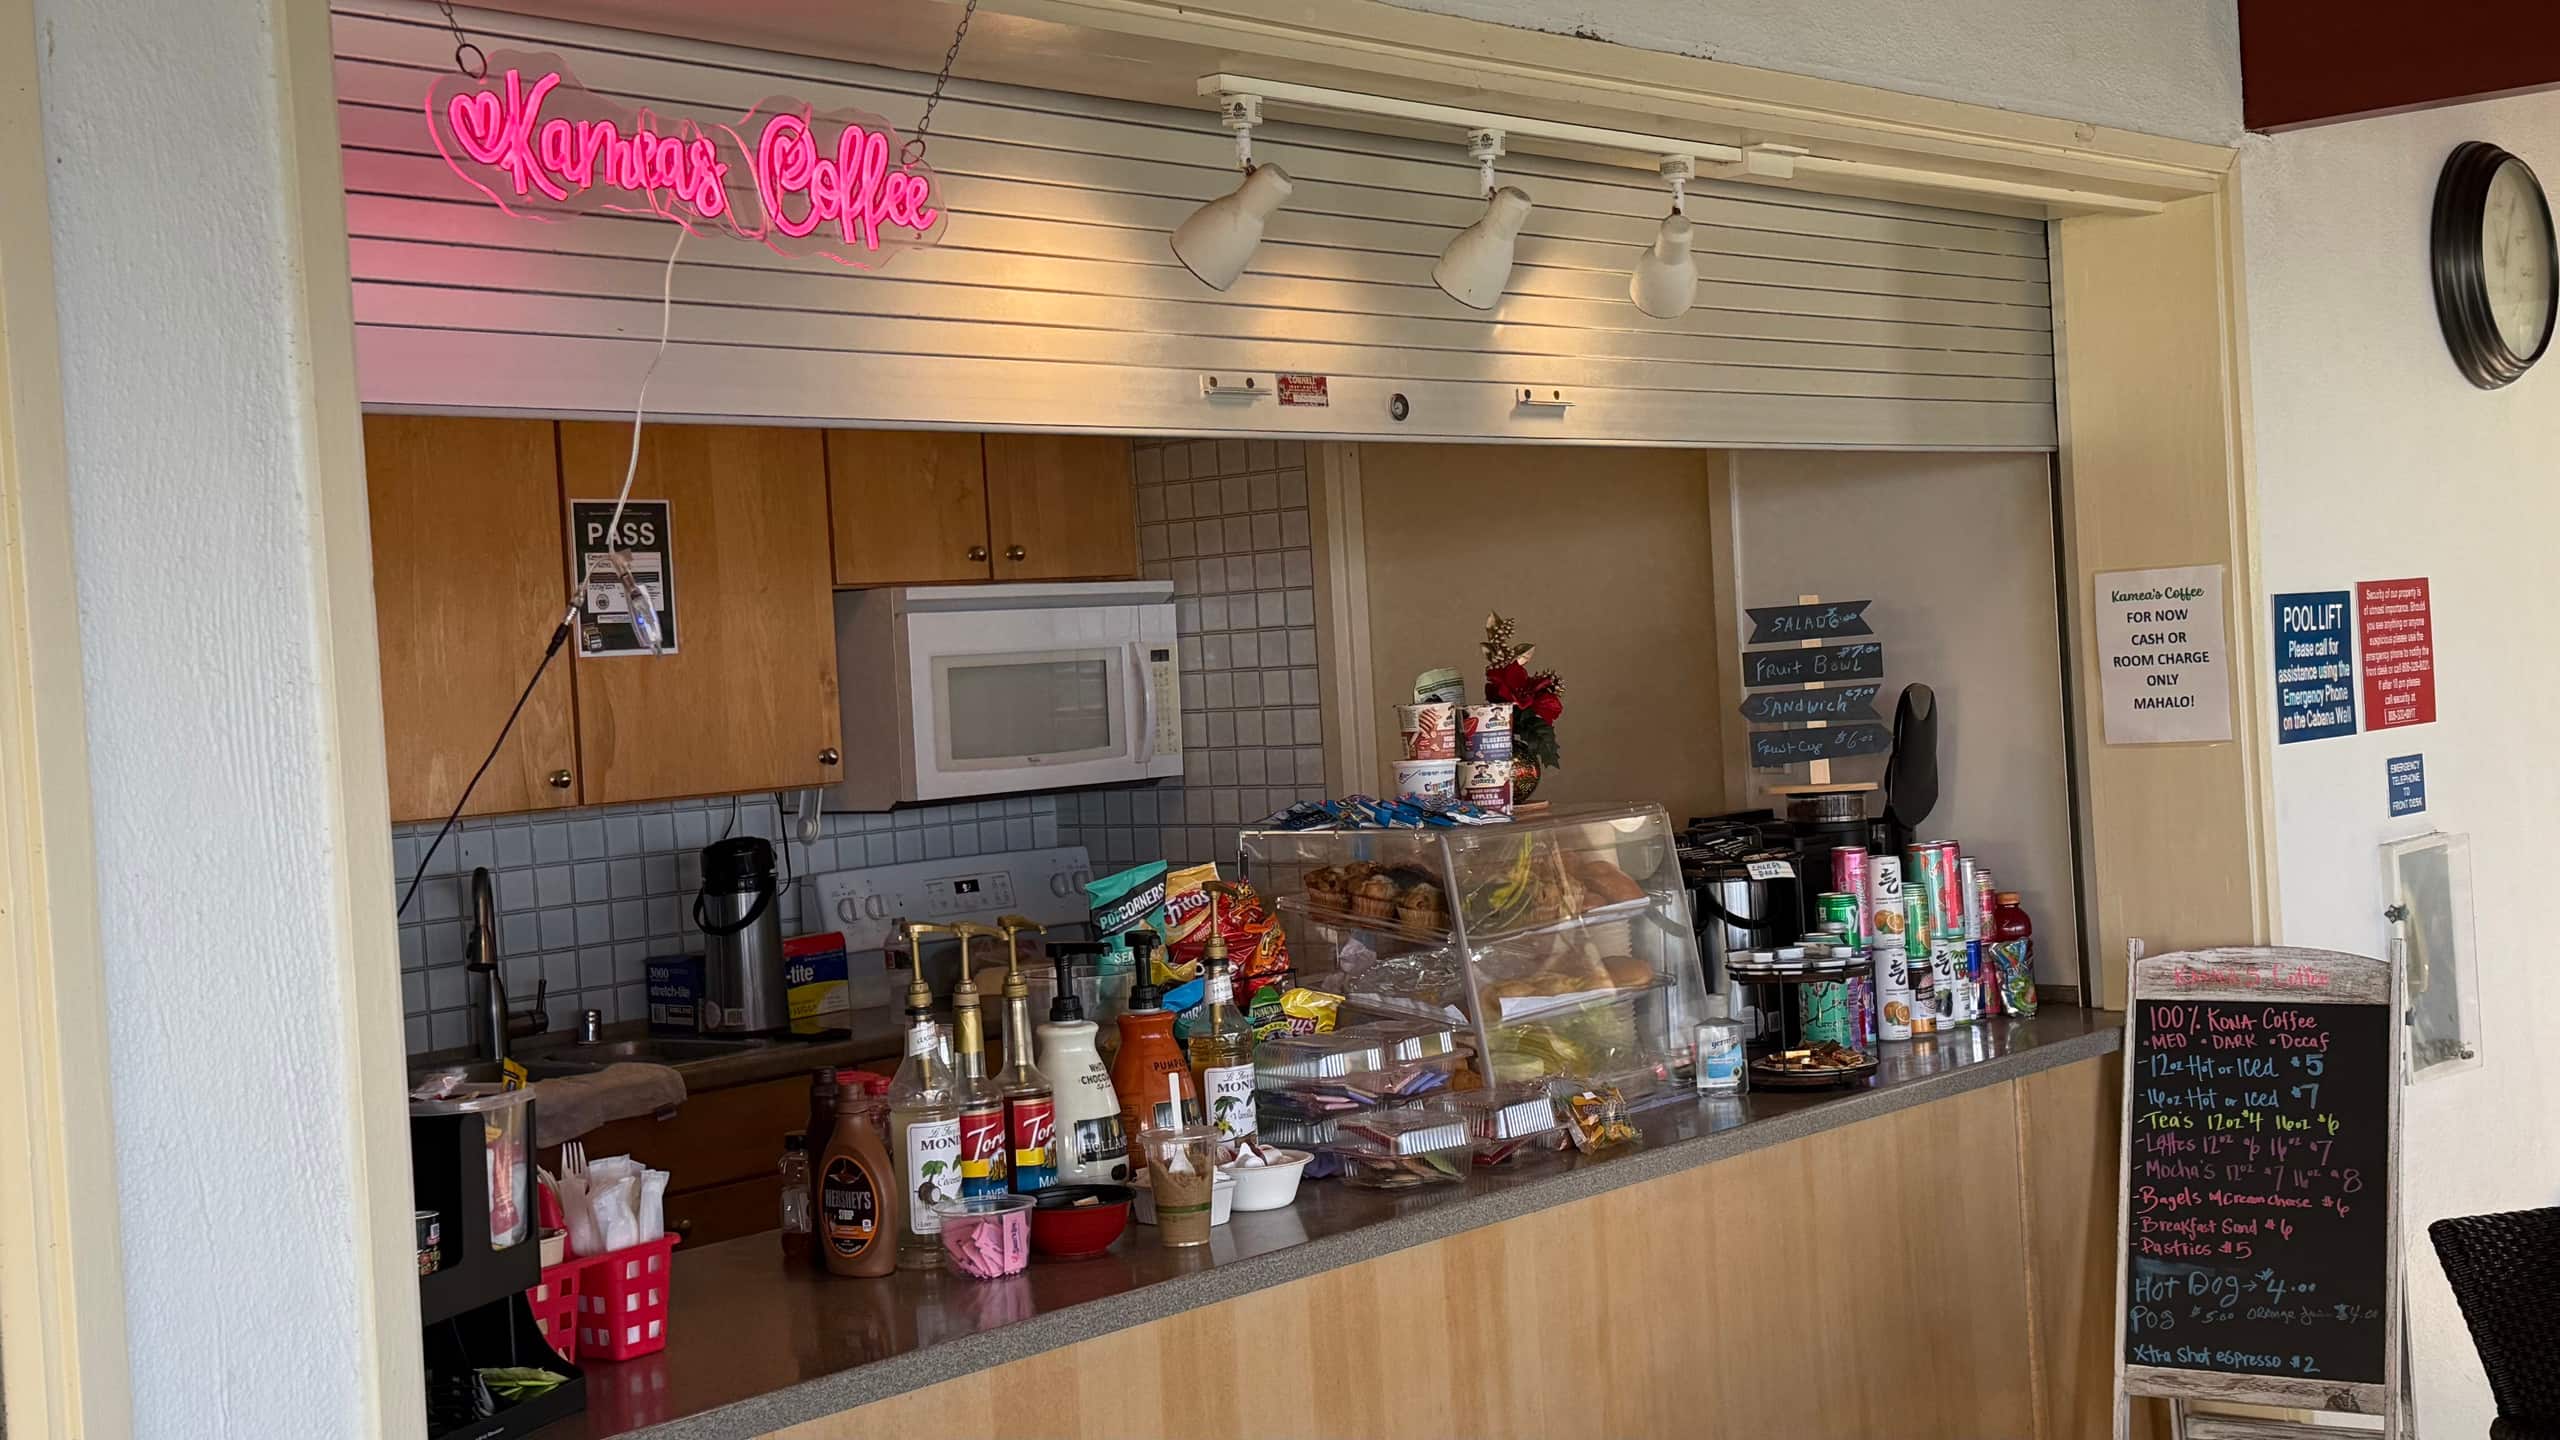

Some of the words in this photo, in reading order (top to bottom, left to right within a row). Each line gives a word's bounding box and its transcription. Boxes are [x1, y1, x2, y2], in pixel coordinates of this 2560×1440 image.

[758, 113, 938, 250] Coffee
[587, 522, 656, 546] PASS
[2111, 588, 2162, 603] Kamea's
[2164, 587, 2204, 601] Coffee
[1771, 615, 1826, 633] SALAD
[2127, 611, 2152, 623] FOR
[2155, 608, 2188, 622] NOW
[2284, 605, 2317, 632] POOL
[2318, 604, 2343, 630] LIFT
[2131, 632, 2164, 645] CASH
[2168, 632, 2187, 643] OR
[2288, 640, 2313, 658] Please
[2315, 638, 2327, 656] call
[2328, 637, 2340, 655] for
[2113, 655, 2154, 668] ROOM
[2158, 651, 2210, 665] CHARGE
[2146, 674, 2179, 686] ONLY
[2278, 664, 2317, 683] assistance
[2319, 662, 2338, 682] using
[2338, 660, 2350, 677] the
[2134, 695, 2194, 709] MAHALO!
[2283, 688, 2324, 708] Emergency
[2325, 684, 2348, 702] Phone
[2283, 716, 2293, 730] on
[2294, 712, 2306, 729] the
[2306, 710, 2335, 728] Cabana
[2335, 705, 2352, 723] Wall
[1100, 883, 1165, 929] POPCORNERS
[2150, 1005, 2201, 1035] 100%
[2262, 1007, 2317, 1031] Coffee
[2151, 1033, 2187, 1049] MED
[2212, 1033, 2257, 1049] DARK
[2186, 1055, 2215, 1081] Hot
[2218, 1064, 2237, 1075] or
[2237, 1056, 2279, 1078] Iced
[2184, 1086, 2217, 1111] Hot
[2224, 1096, 2239, 1106] or
[2245, 1089, 2279, 1108] Iced
[825, 1189, 872, 1210] HERSHEY'S
[2136, 1185, 2202, 1215] Bagels
[2142, 1236, 2212, 1257] Pastries
[2136, 1277, 2181, 1303] Hot
[2188, 1271, 2240, 1308] Dog
[2176, 1347, 2211, 1365] Shot
[2216, 1350, 2281, 1370] espresso
